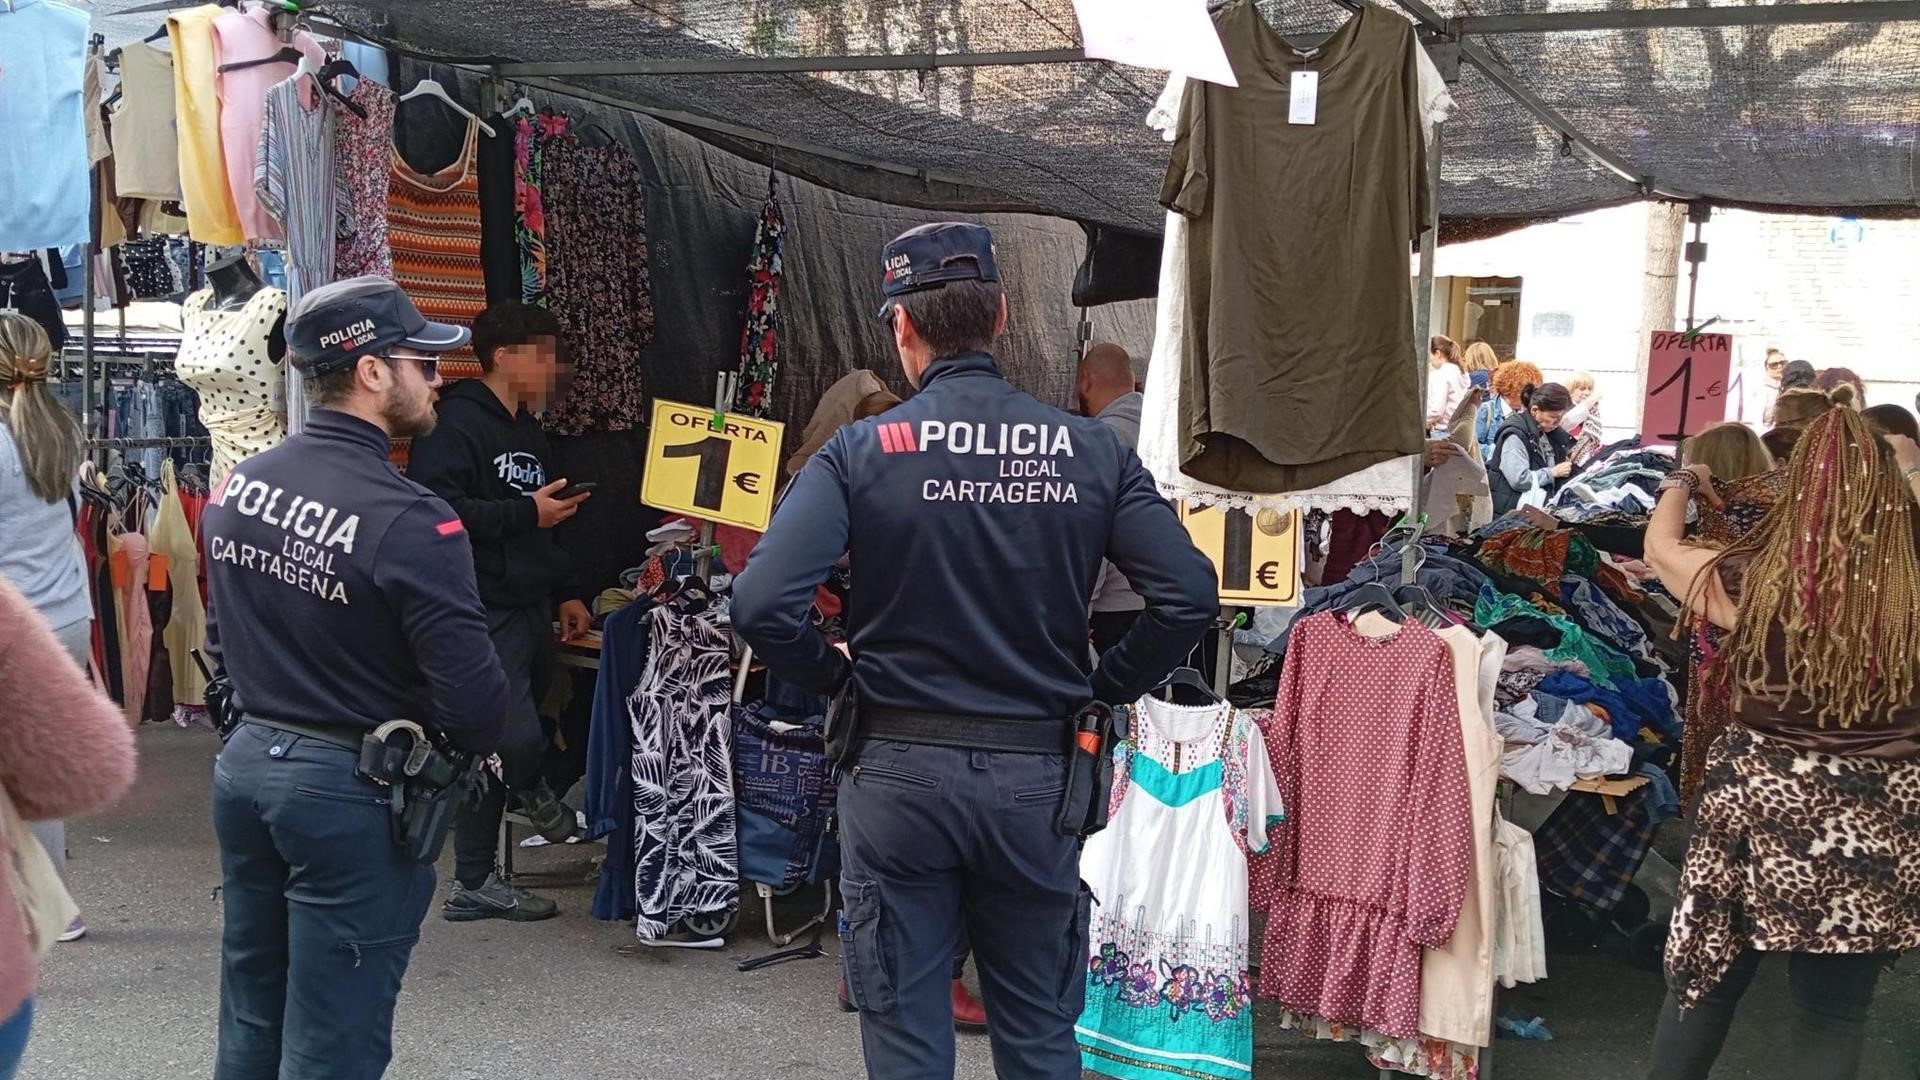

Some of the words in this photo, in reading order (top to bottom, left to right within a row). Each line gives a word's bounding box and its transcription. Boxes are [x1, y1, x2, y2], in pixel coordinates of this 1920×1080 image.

[885, 254, 910, 271] LICIA
[893, 266, 912, 279] LOCAL
[320, 318, 376, 348] POLICIA
[353, 331, 377, 346] LOCAL
[1652, 333, 1728, 352] OFERTA
[919, 420, 1075, 457] POLICIA
[999, 459, 1062, 478] LOCAL
[922, 479, 1079, 504] CARTAGENA
[219, 473, 360, 554] POLICIA
[282, 535, 336, 575] LOCAL
[211, 536, 349, 604] CARTAGENA
